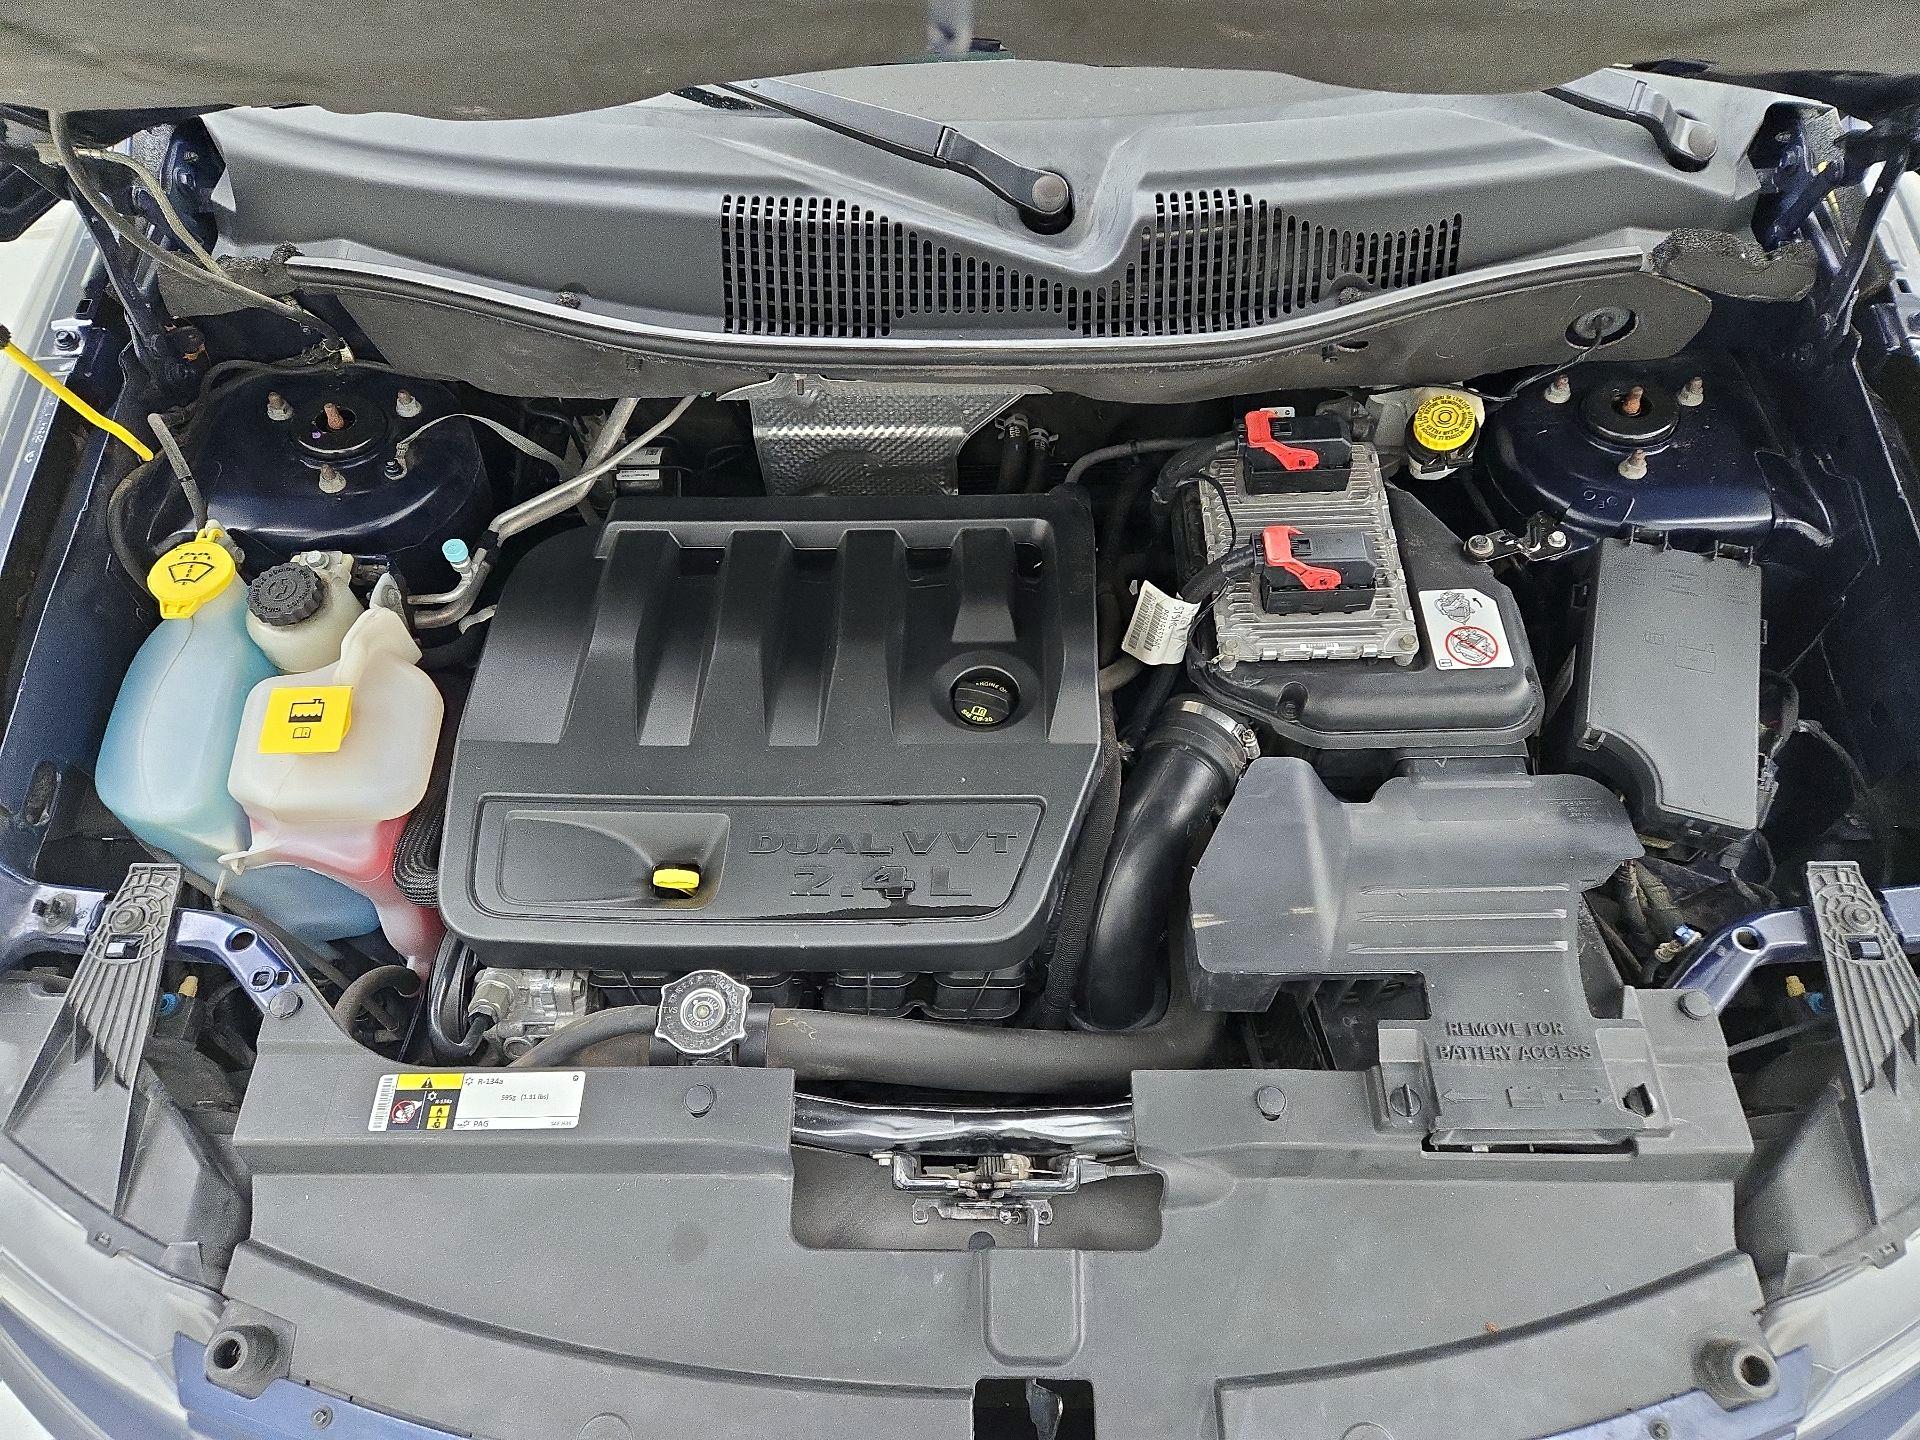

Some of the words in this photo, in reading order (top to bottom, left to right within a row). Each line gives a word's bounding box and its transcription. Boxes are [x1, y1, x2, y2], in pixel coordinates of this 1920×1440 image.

[748, 831, 893, 855] DUAL
[902, 831, 1018, 855] VVT
[1446, 1021, 1524, 1037] REMOVE
[1526, 1021, 1565, 1037] FOR
[1437, 1044, 1512, 1061] BATTERY
[1519, 1044, 1591, 1060] ACCESS
[473, 1120, 489, 1128] PAG
